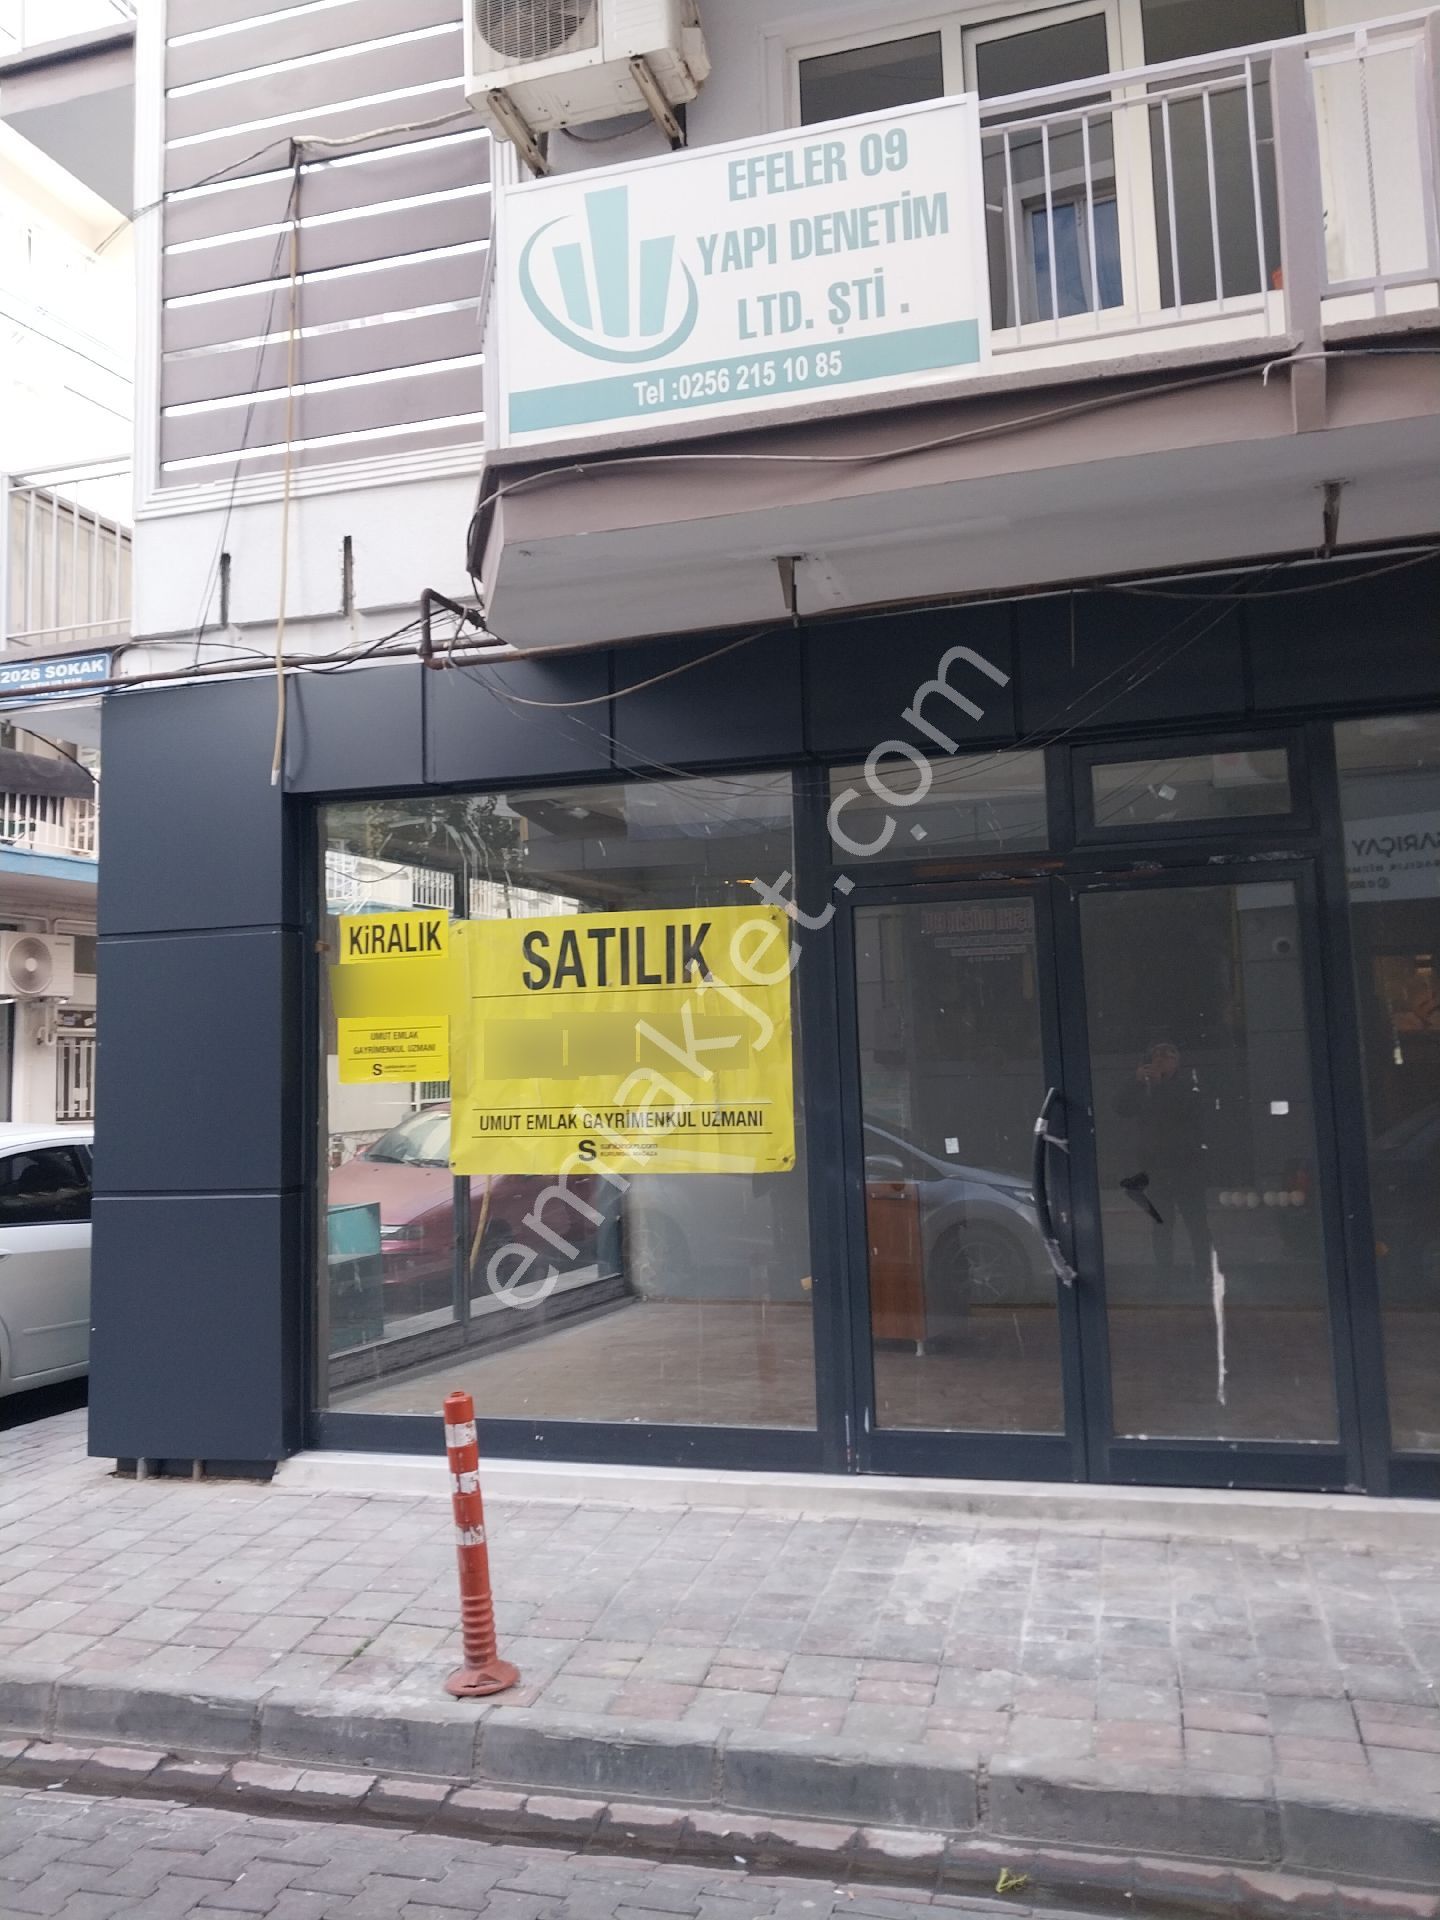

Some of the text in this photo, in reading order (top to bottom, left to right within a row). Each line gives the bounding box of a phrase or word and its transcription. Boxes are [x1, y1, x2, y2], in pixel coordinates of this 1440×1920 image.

[728, 127, 909, 201] EFELER 09
[697, 190, 949, 276] YAPI DENETİM
[737, 287, 814, 340] LTD.
[633, 376, 666, 406] Tel
[736, 361, 776, 391] 215
[782, 355, 809, 384] 10
[815, 350, 842, 379] 85
[1, 667, 41, 684] 2026
[45, 659, 105, 679] SOKAK
[522, 922, 714, 990] SATILIK
[370, 1031, 418, 1040] UMUT EMLAK
[407, 1044, 436, 1052] UZMANI
[372, 1063, 383, 1076] S
[480, 1110, 763, 1131] UMUT EMLAK GAYRİMENKUL UZMANI
[578, 1139, 597, 1161] S
